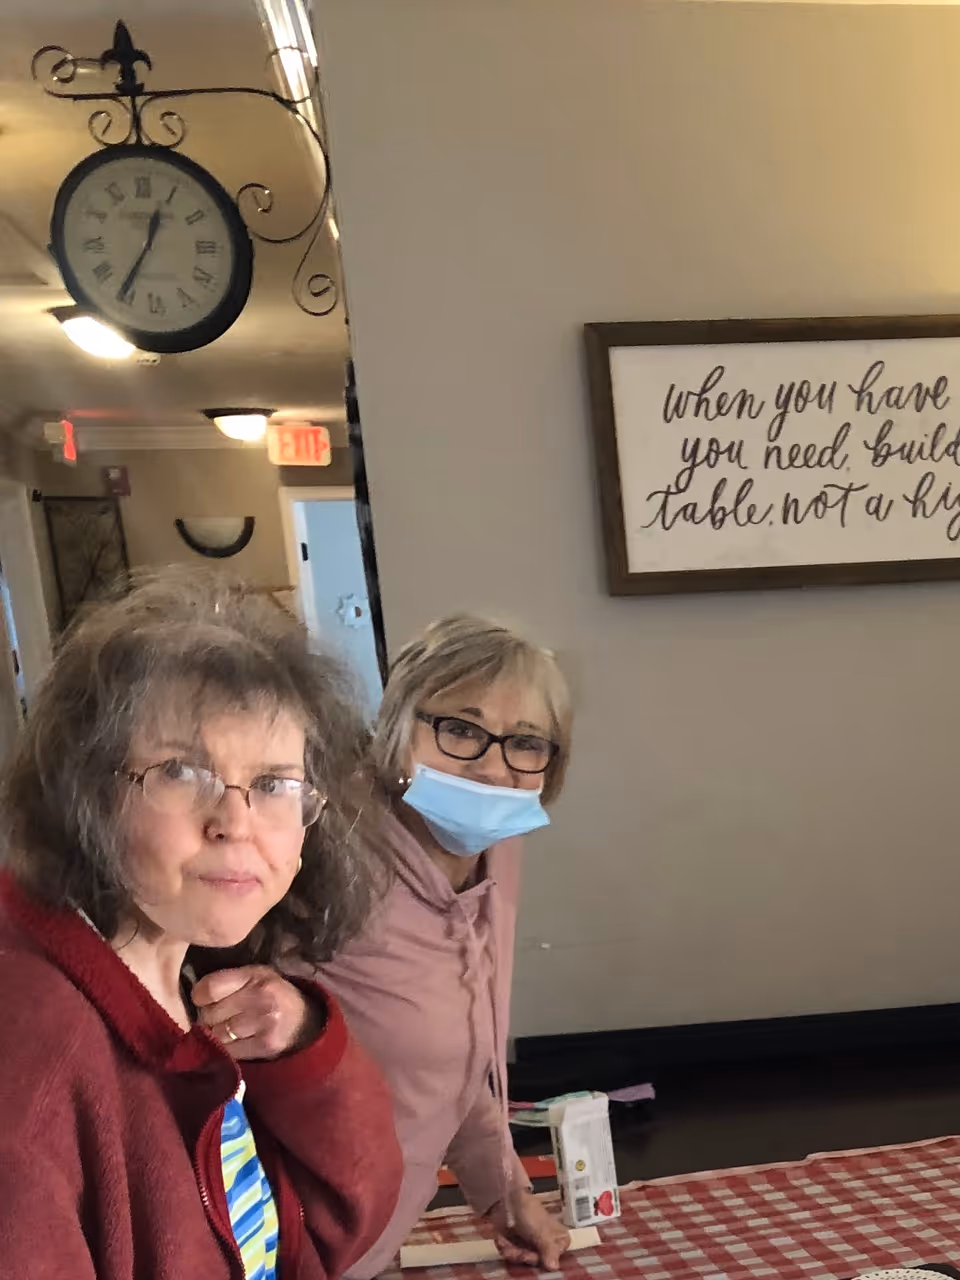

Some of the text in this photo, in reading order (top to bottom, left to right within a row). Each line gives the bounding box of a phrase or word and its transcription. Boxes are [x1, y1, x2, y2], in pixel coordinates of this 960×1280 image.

[767, 379, 837, 442] you
[848, 360, 950, 415] have
[278, 428, 321, 461] EXIT
[675, 437, 748, 493] you
[781, 482, 870, 529] not
[864, 493, 895, 522] a
